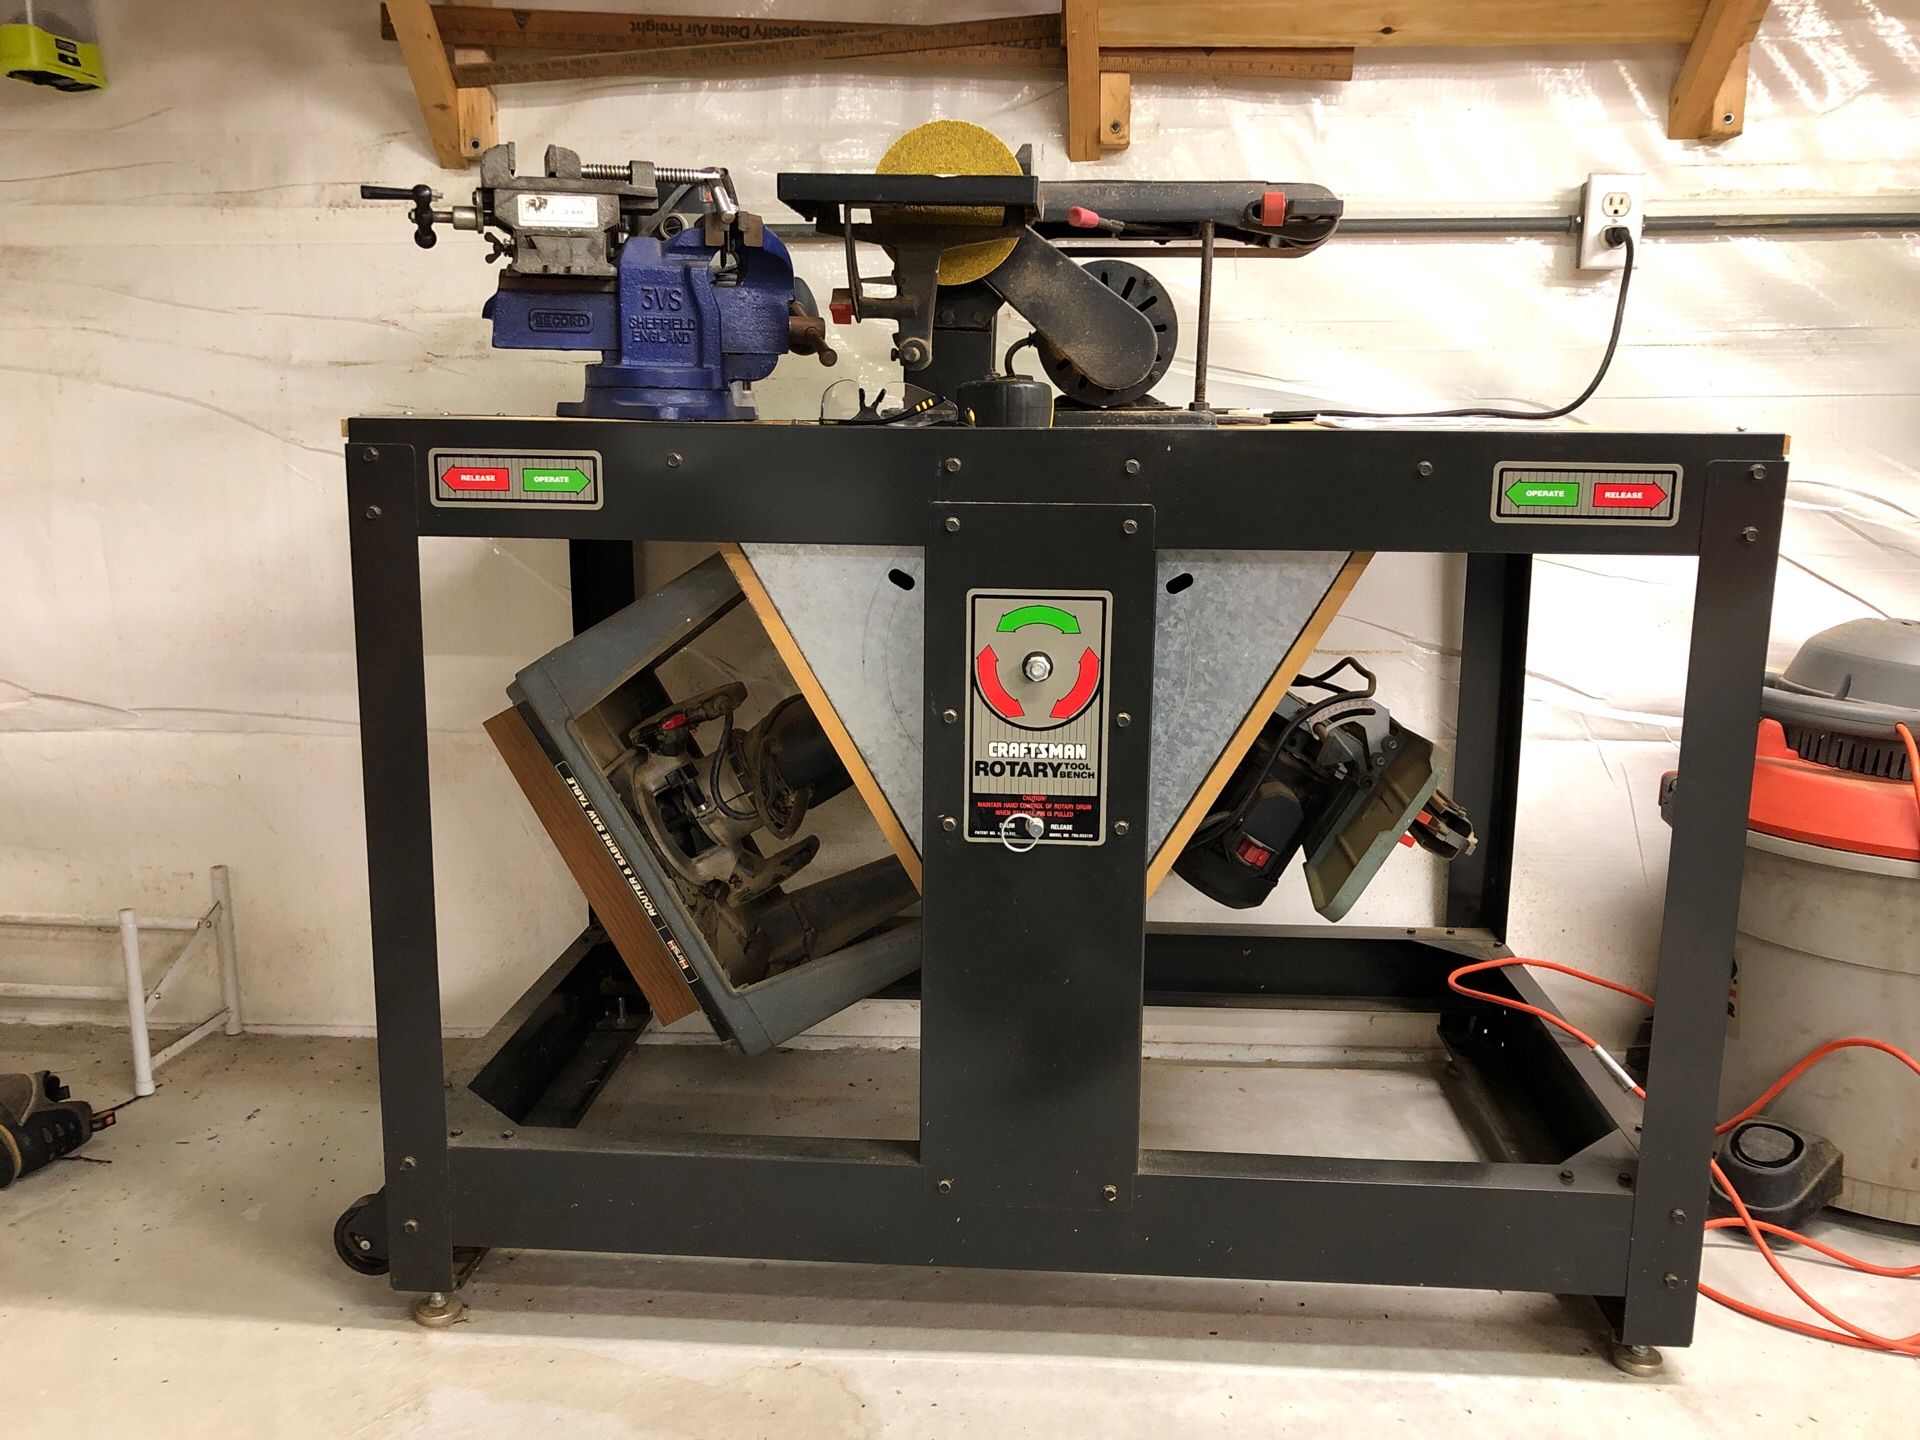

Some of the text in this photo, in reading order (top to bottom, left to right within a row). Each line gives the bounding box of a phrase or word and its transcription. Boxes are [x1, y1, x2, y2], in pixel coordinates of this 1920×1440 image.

[629, 19, 683, 36] Freight
[685, 22, 707, 37] Air
[711, 23, 750, 39] Delta
[753, 23, 811, 40] Specify
[641, 287, 683, 311] 3VS
[629, 315, 697, 331] SHEFFIELD
[632, 329, 692, 344] ENGLAND
[460, 474, 496, 482] RELEASE
[1525, 490, 1564, 498] OPERATE
[1604, 491, 1643, 499] RELEASE
[988, 741, 1087, 760] CRAFTSMAN
[974, 760, 1091, 778] ROTARY TOOL
[1060, 771, 1095, 779] BENCH
[566, 776, 658, 917] ROUTER & SABRE SAW TABLE
